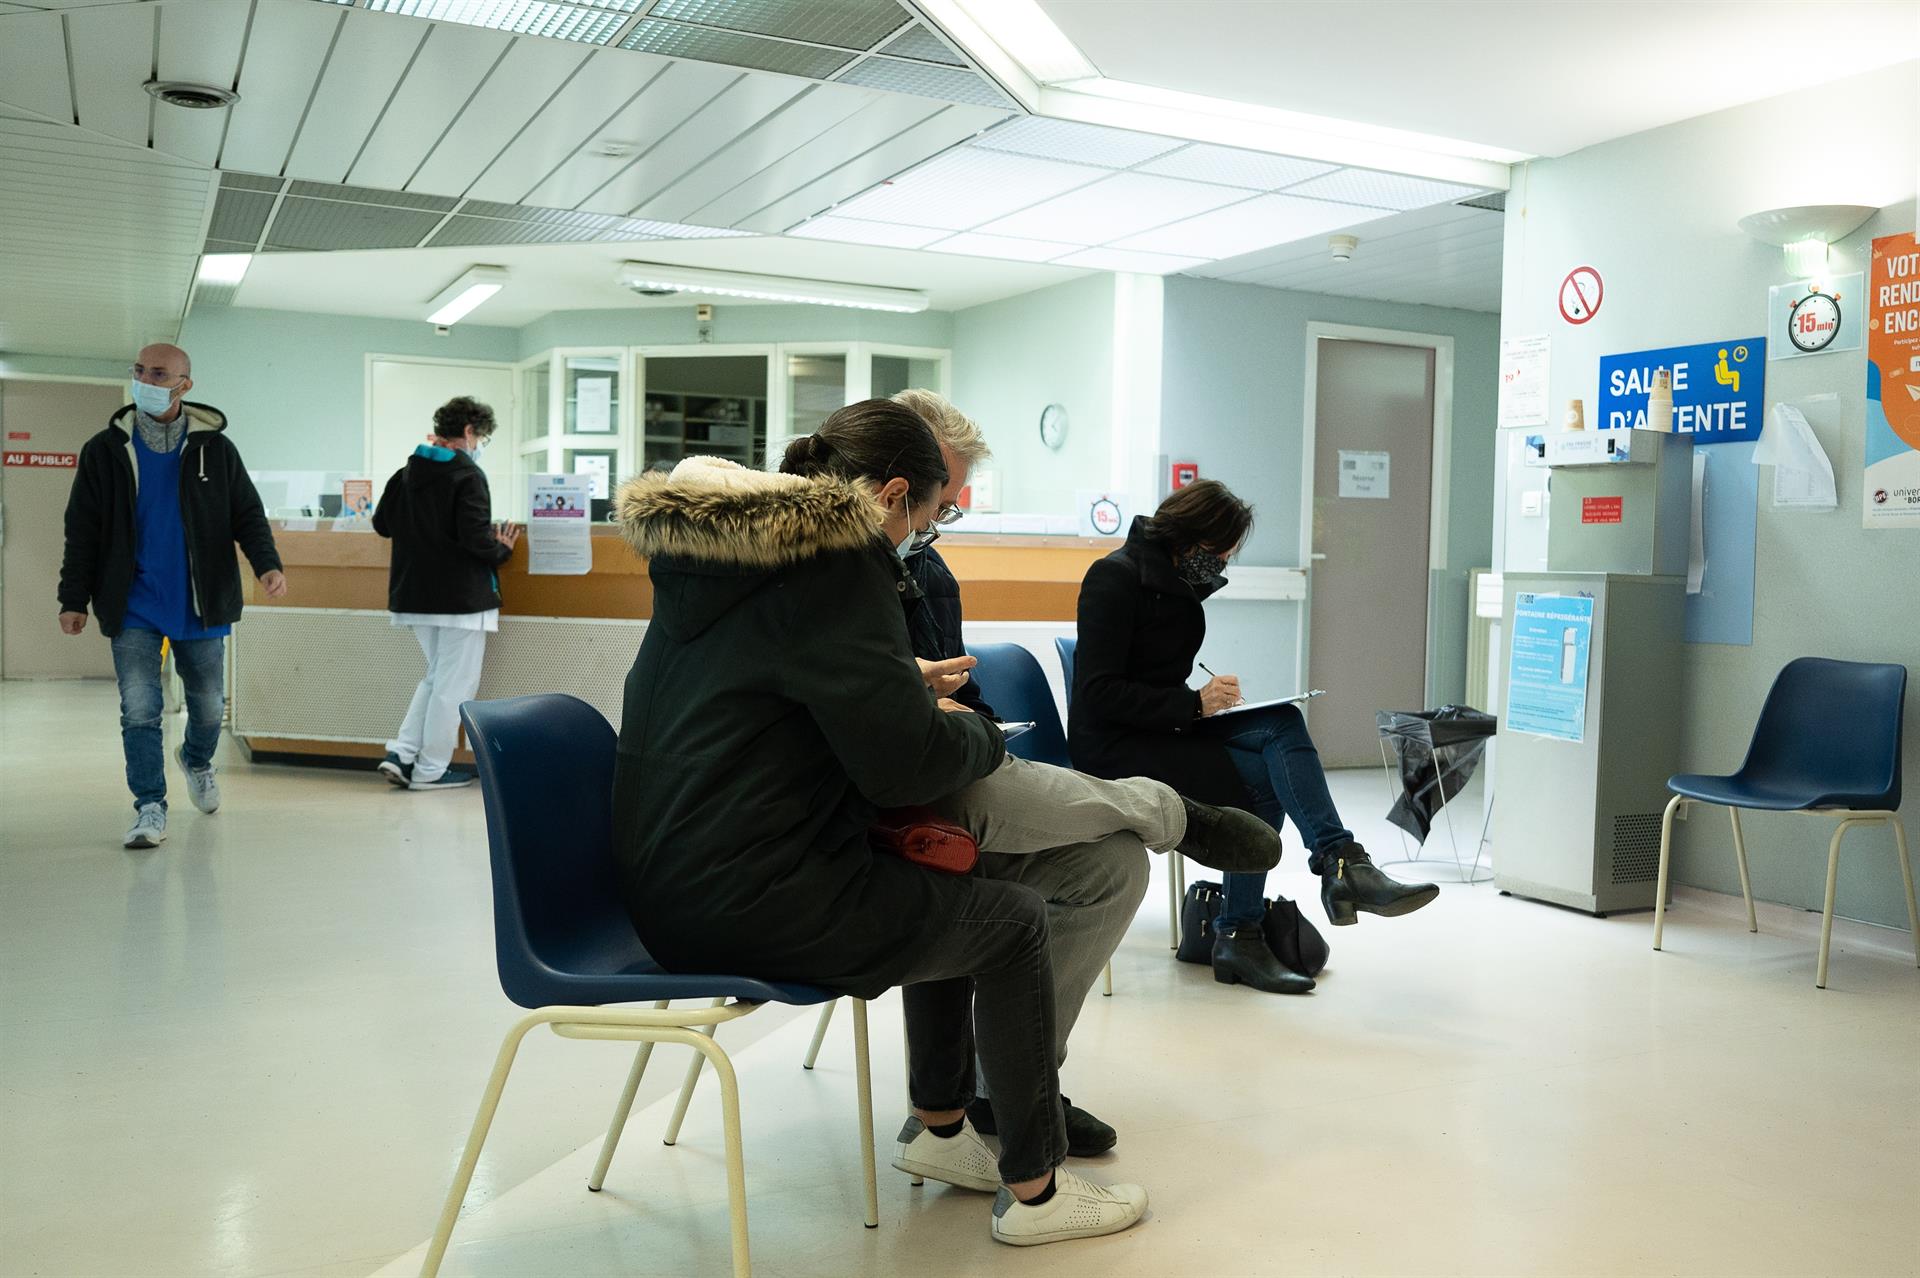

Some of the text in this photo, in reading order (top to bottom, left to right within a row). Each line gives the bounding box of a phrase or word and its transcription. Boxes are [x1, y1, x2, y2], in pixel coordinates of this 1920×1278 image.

[1887, 253, 1920, 278] VOT
[1798, 312, 1816, 333] 15
[1885, 309, 1920, 334] ENC
[1610, 362, 1688, 396] SALE
[1610, 401, 1747, 432] D'AENTE
[6, 454, 74, 466] AU PUBLIC
[1097, 510, 1107, 522] 15
